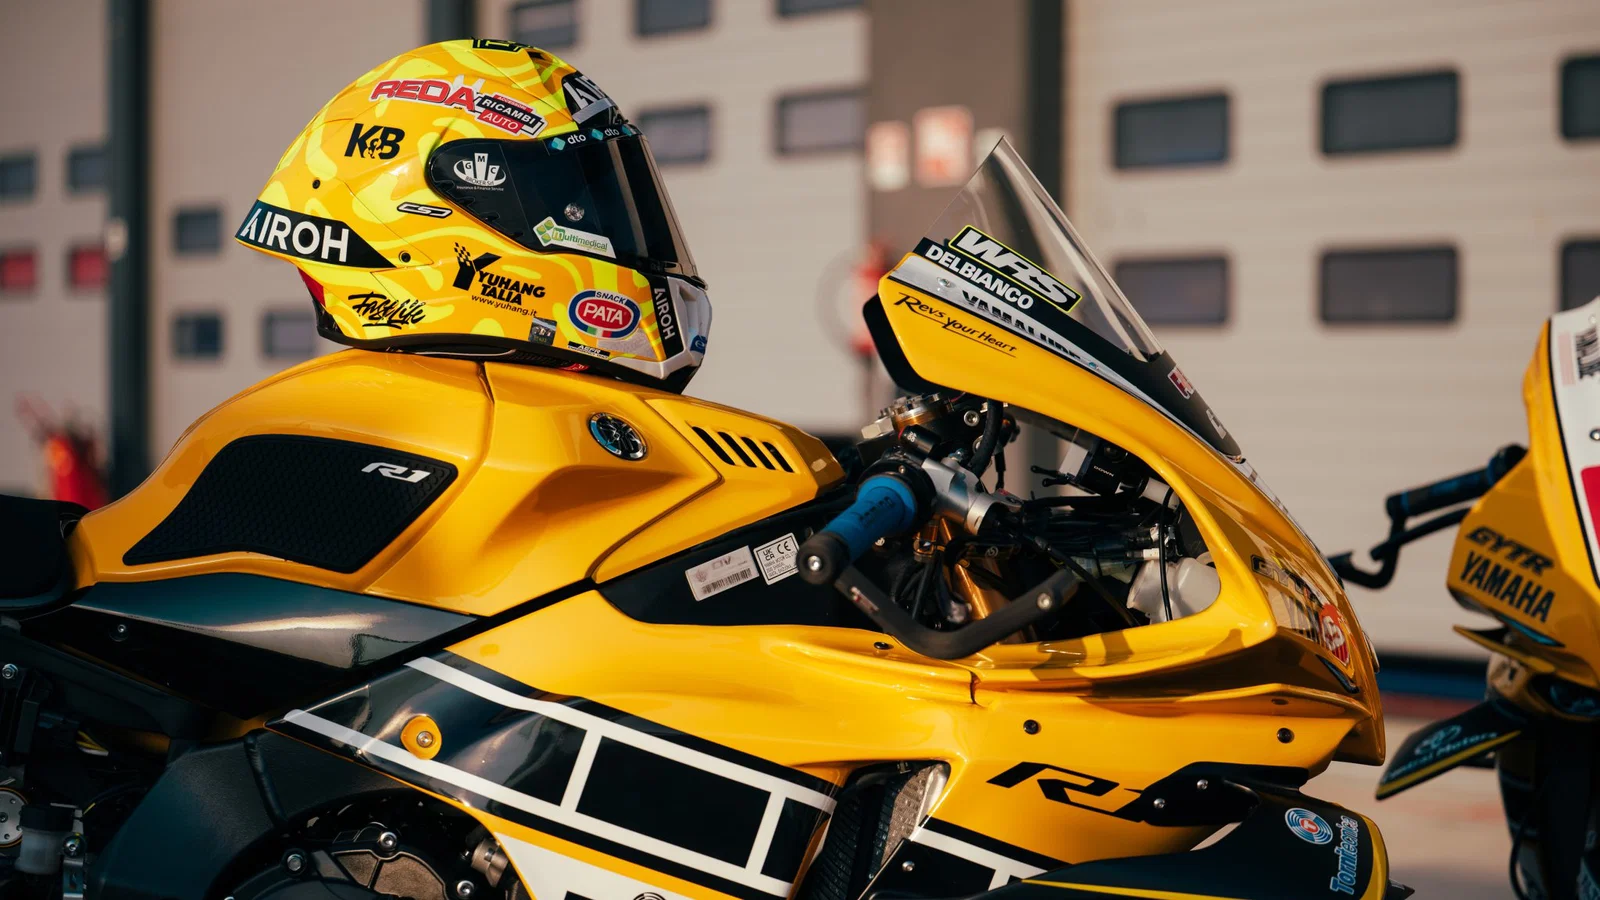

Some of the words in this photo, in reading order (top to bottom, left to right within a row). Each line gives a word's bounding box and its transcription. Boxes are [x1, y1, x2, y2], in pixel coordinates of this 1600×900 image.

[371, 80, 475, 113] REDA
[482, 99, 536, 125] RICAMBI
[483, 113, 518, 130] AUTO
[567, 134, 587, 145] dto
[604, 128, 620, 137] dto
[240, 208, 350, 263] AIROH
[552, 227, 608, 250] multimedical
[925, 244, 1034, 309] DELBIANCO
[956, 229, 1077, 303] WRS
[478, 270, 546, 298] YUHANG
[481, 284, 522, 305] TALIA
[471, 295, 537, 316] www.yuhang.it
[596, 291, 627, 304] SNACK
[583, 302, 623, 325] PATA
[654, 287, 676, 340] AIROH
[894, 292, 946, 318] Revs
[942, 317, 980, 335] your
[978, 331, 1017, 352] Heart
[361, 462, 431, 483] R1
[1465, 526, 1554, 576] GYTR
[1460, 550, 1555, 623] YAMAHA
